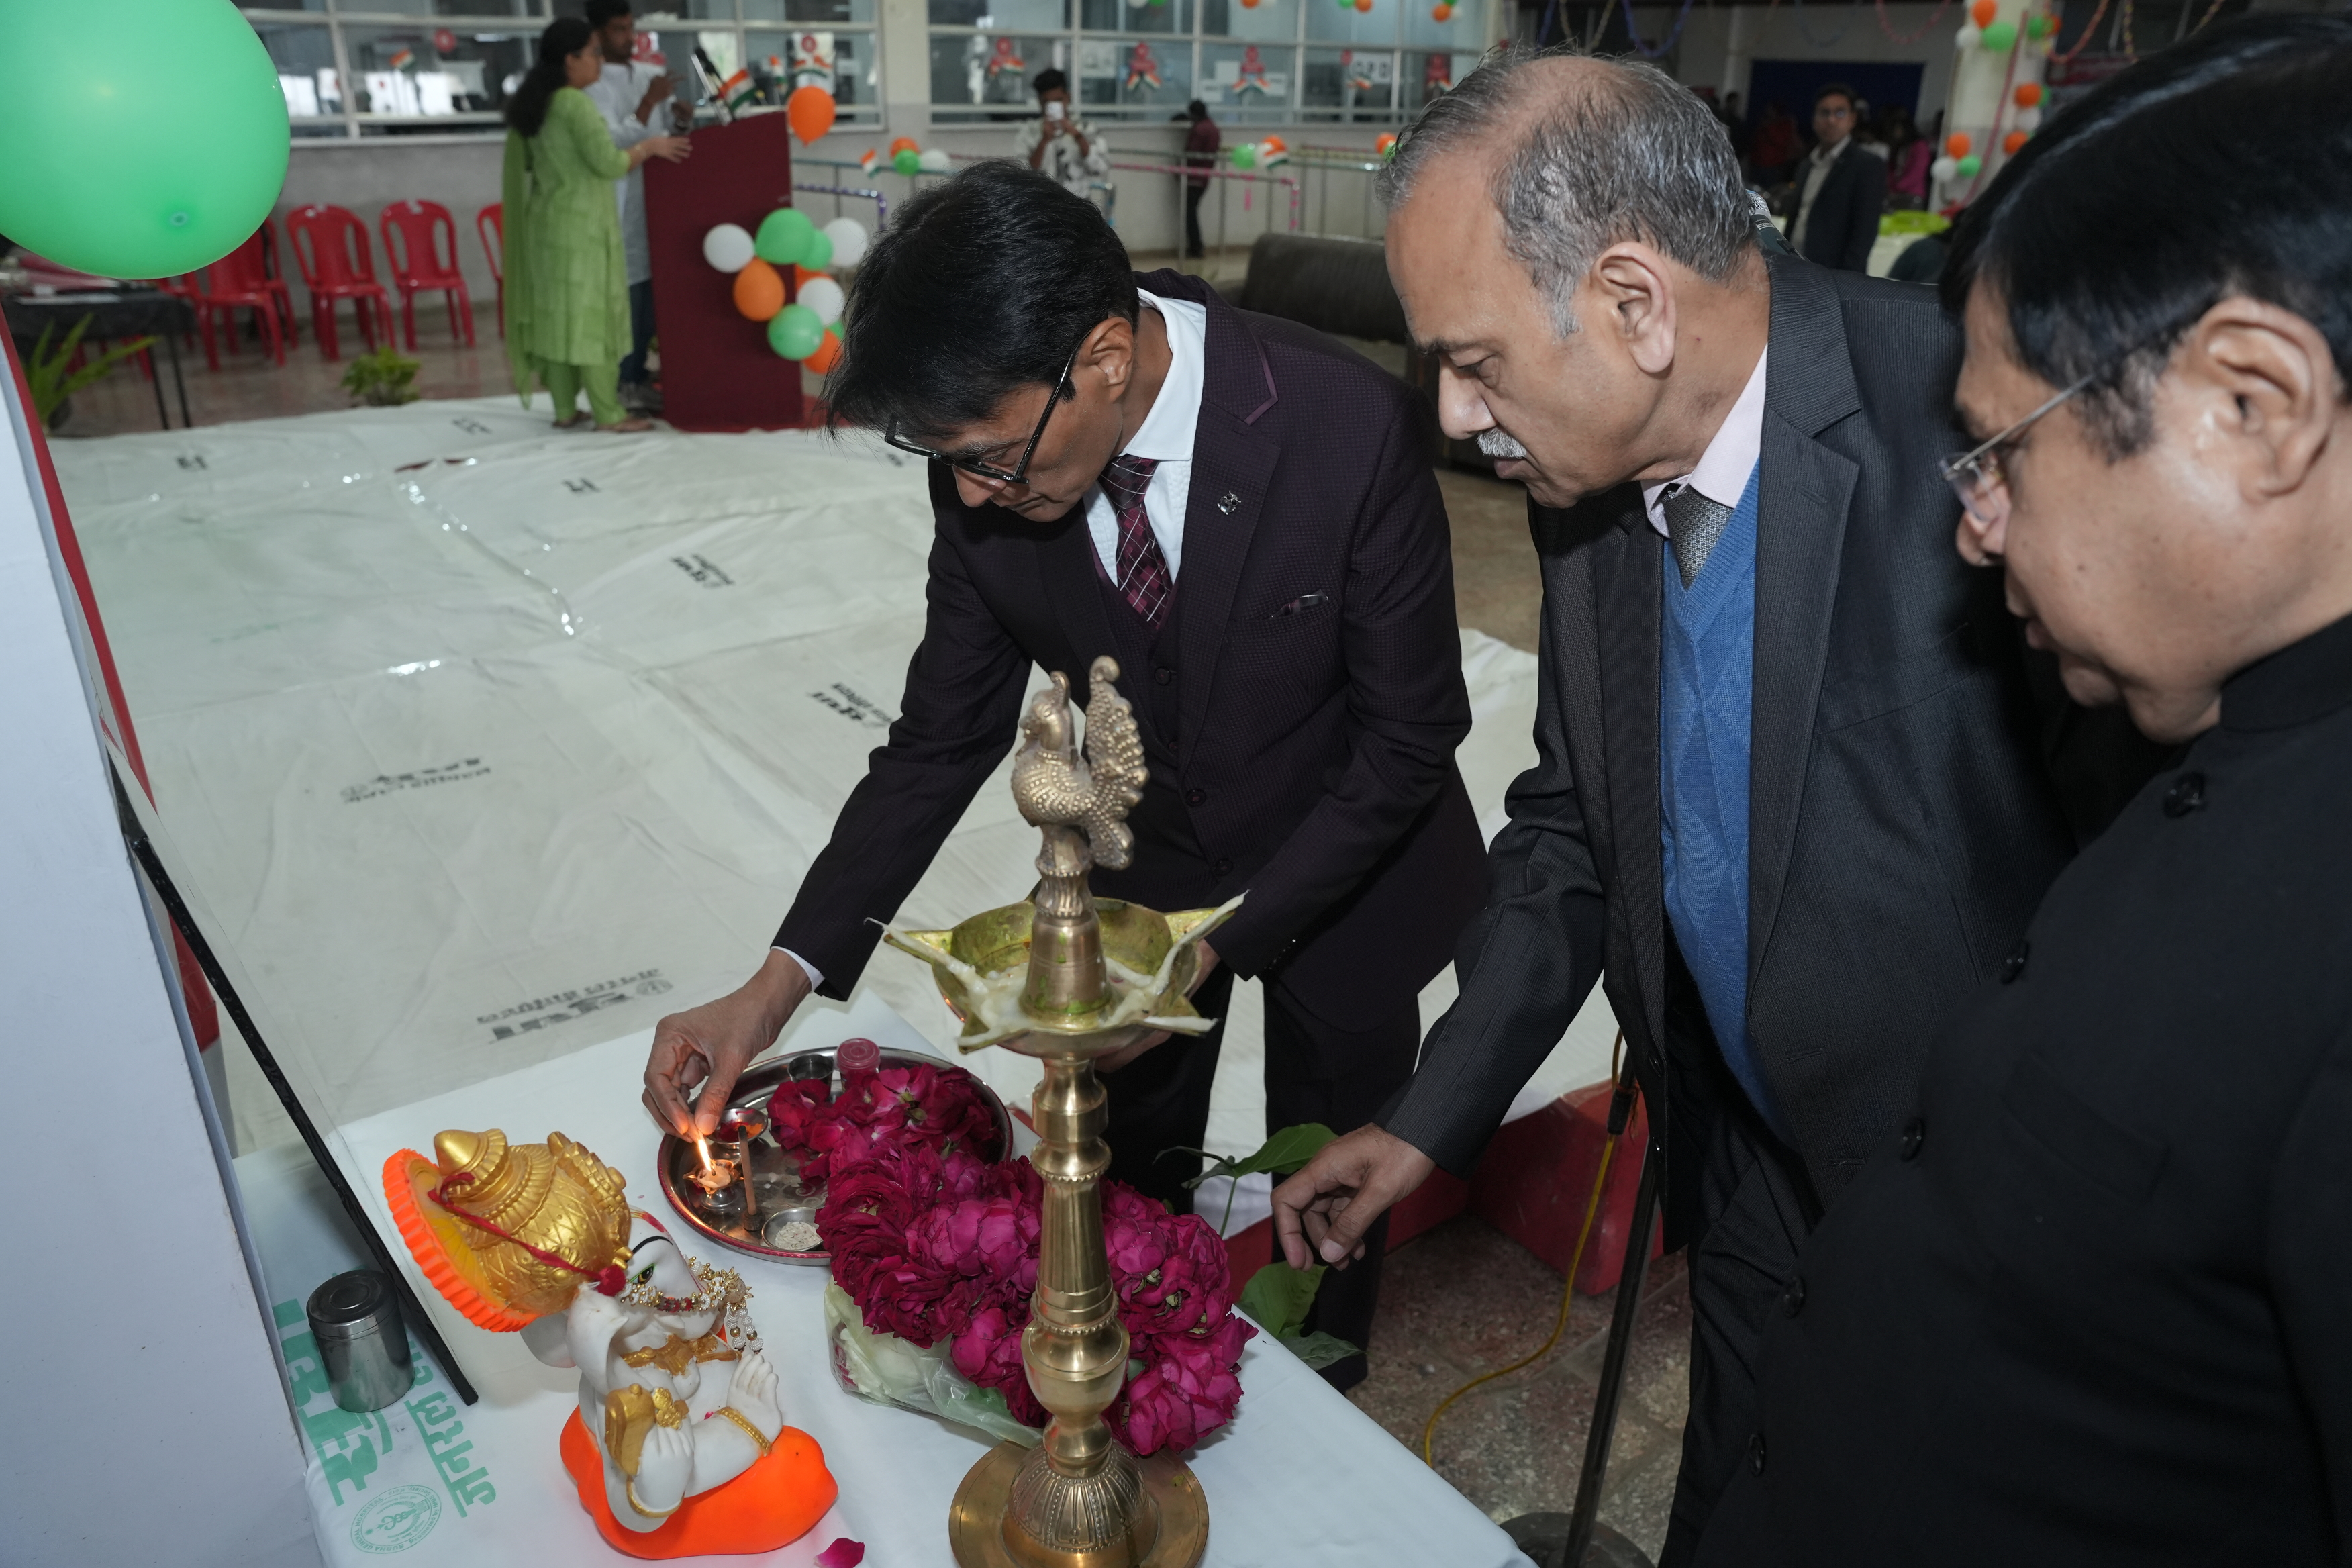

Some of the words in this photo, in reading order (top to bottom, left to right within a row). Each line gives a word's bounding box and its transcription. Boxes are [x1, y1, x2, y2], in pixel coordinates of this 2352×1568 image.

[403, 1390, 497, 1518] जनरल
[387, 1487, 406, 1496] Kota
[354, 1496, 383, 1526] HOSPITAL
[354, 1528, 373, 1550] GENERAL
[409, 1516, 435, 1544] Promoted
[374, 1543, 404, 1551] SUDHA
